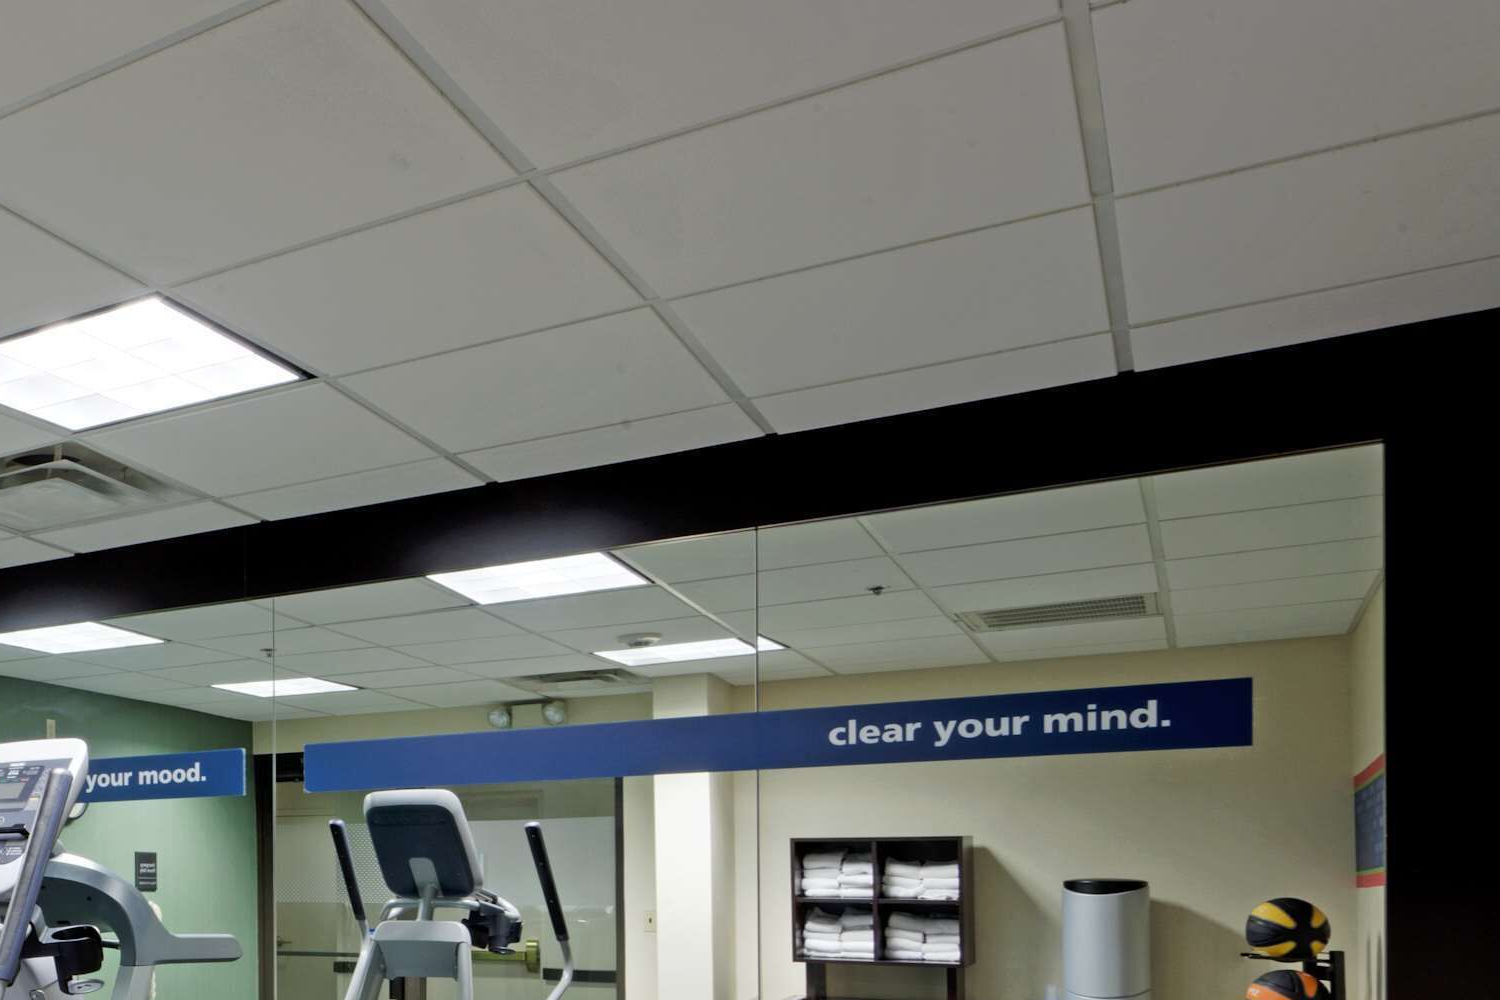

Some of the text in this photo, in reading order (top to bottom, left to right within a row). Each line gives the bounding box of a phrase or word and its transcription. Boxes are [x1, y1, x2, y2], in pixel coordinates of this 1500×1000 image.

[828, 699, 1172, 748] clear your mind.
[84, 761, 207, 794] your mood.
